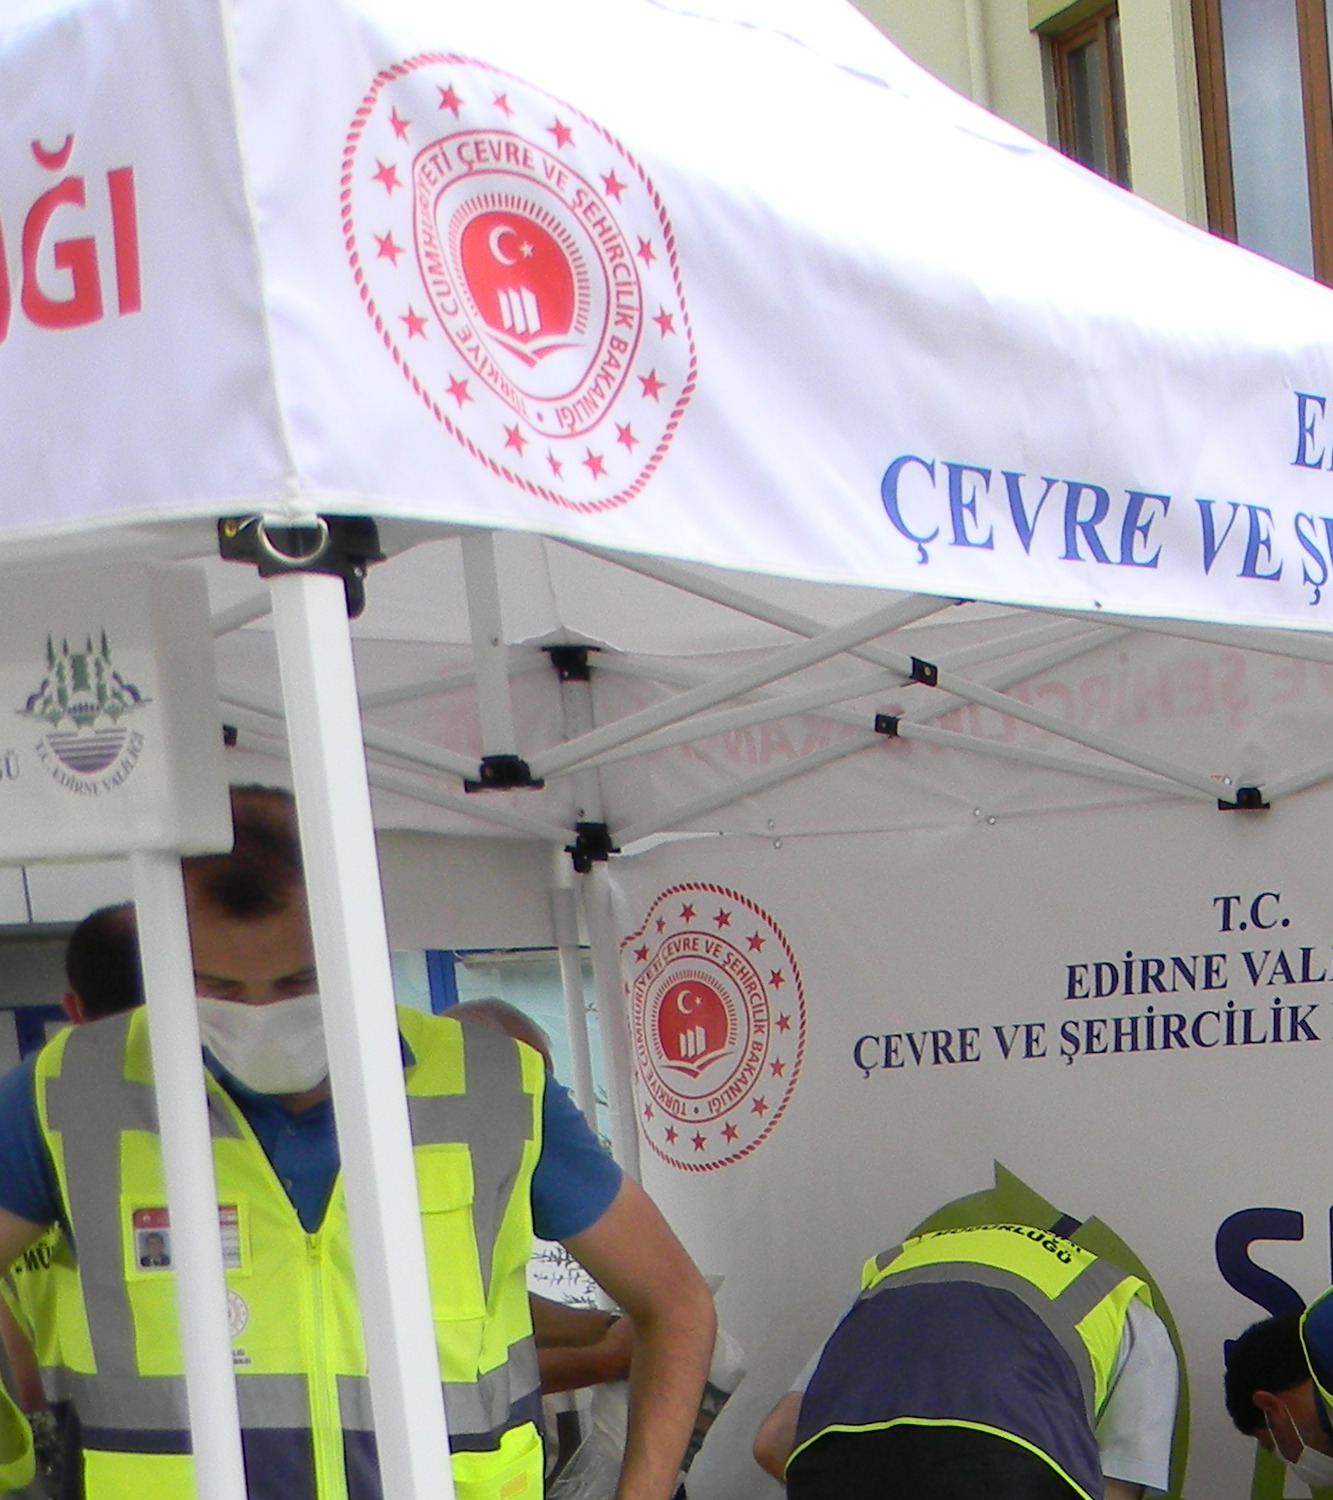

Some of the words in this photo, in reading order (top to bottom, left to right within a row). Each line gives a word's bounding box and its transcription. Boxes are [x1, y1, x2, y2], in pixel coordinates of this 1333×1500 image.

[0, 133, 141, 343] ĞI
[456, 139, 536, 171] ÇEVRE
[542, 157, 568, 192] VE
[570, 187, 636, 330] ŞEHİRCİLİK
[880, 454, 1172, 569] ÇEVRE
[1195, 497, 1284, 581] VE
[703, 938, 724, 960] VE
[1213, 892, 1291, 933] T.C.
[721, 951, 766, 1036] ŞEHİRCİLİK
[1064, 950, 1228, 1001] EDİRNE
[707, 1041, 765, 1115] BAKANLIĞI
[853, 1027, 981, 1079] ÇEVRE
[993, 1023, 1047, 1061] VE
[1059, 997, 1320, 1065] ŞEHİRCİLİK
